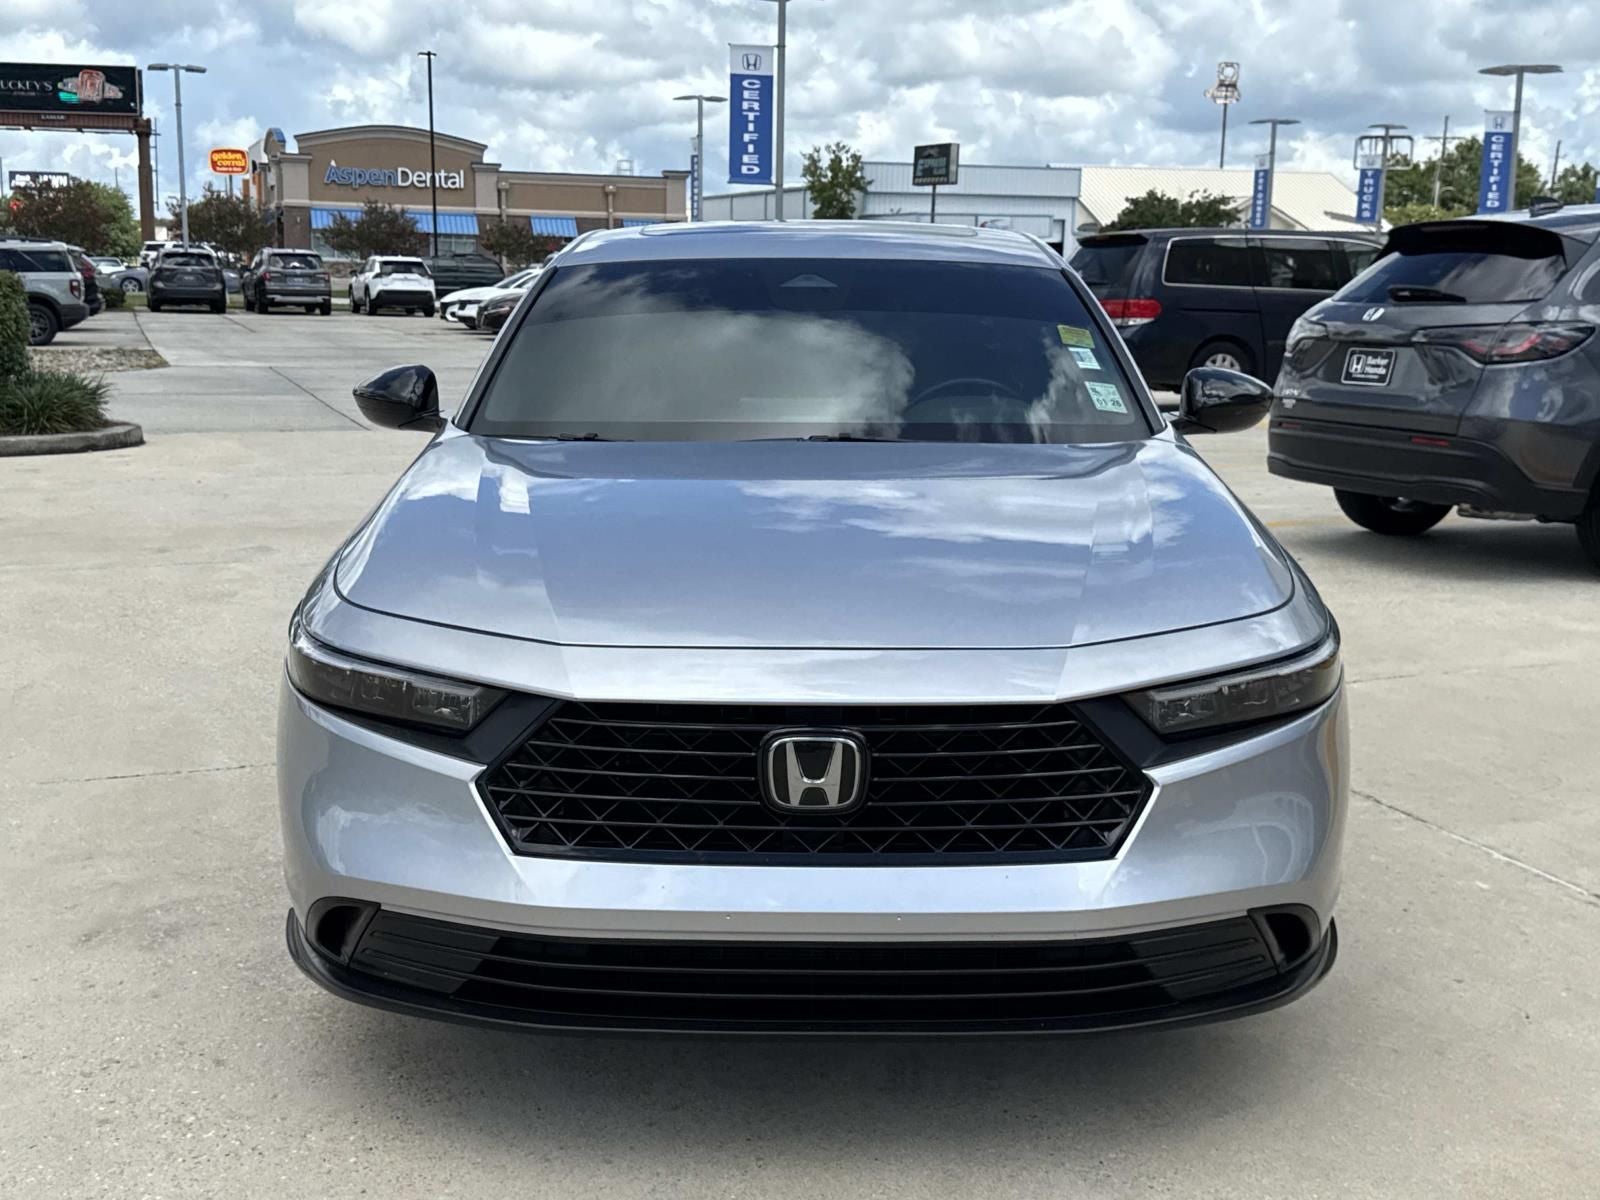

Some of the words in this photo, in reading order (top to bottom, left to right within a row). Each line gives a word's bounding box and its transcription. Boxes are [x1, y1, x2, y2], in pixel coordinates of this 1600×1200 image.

[742, 79, 761, 175] CERTIFIED
[1361, 170, 1375, 218] TRUCKS
[1486, 135, 1504, 208] CERTIFIED
[1364, 365, 1387, 375] Honda
